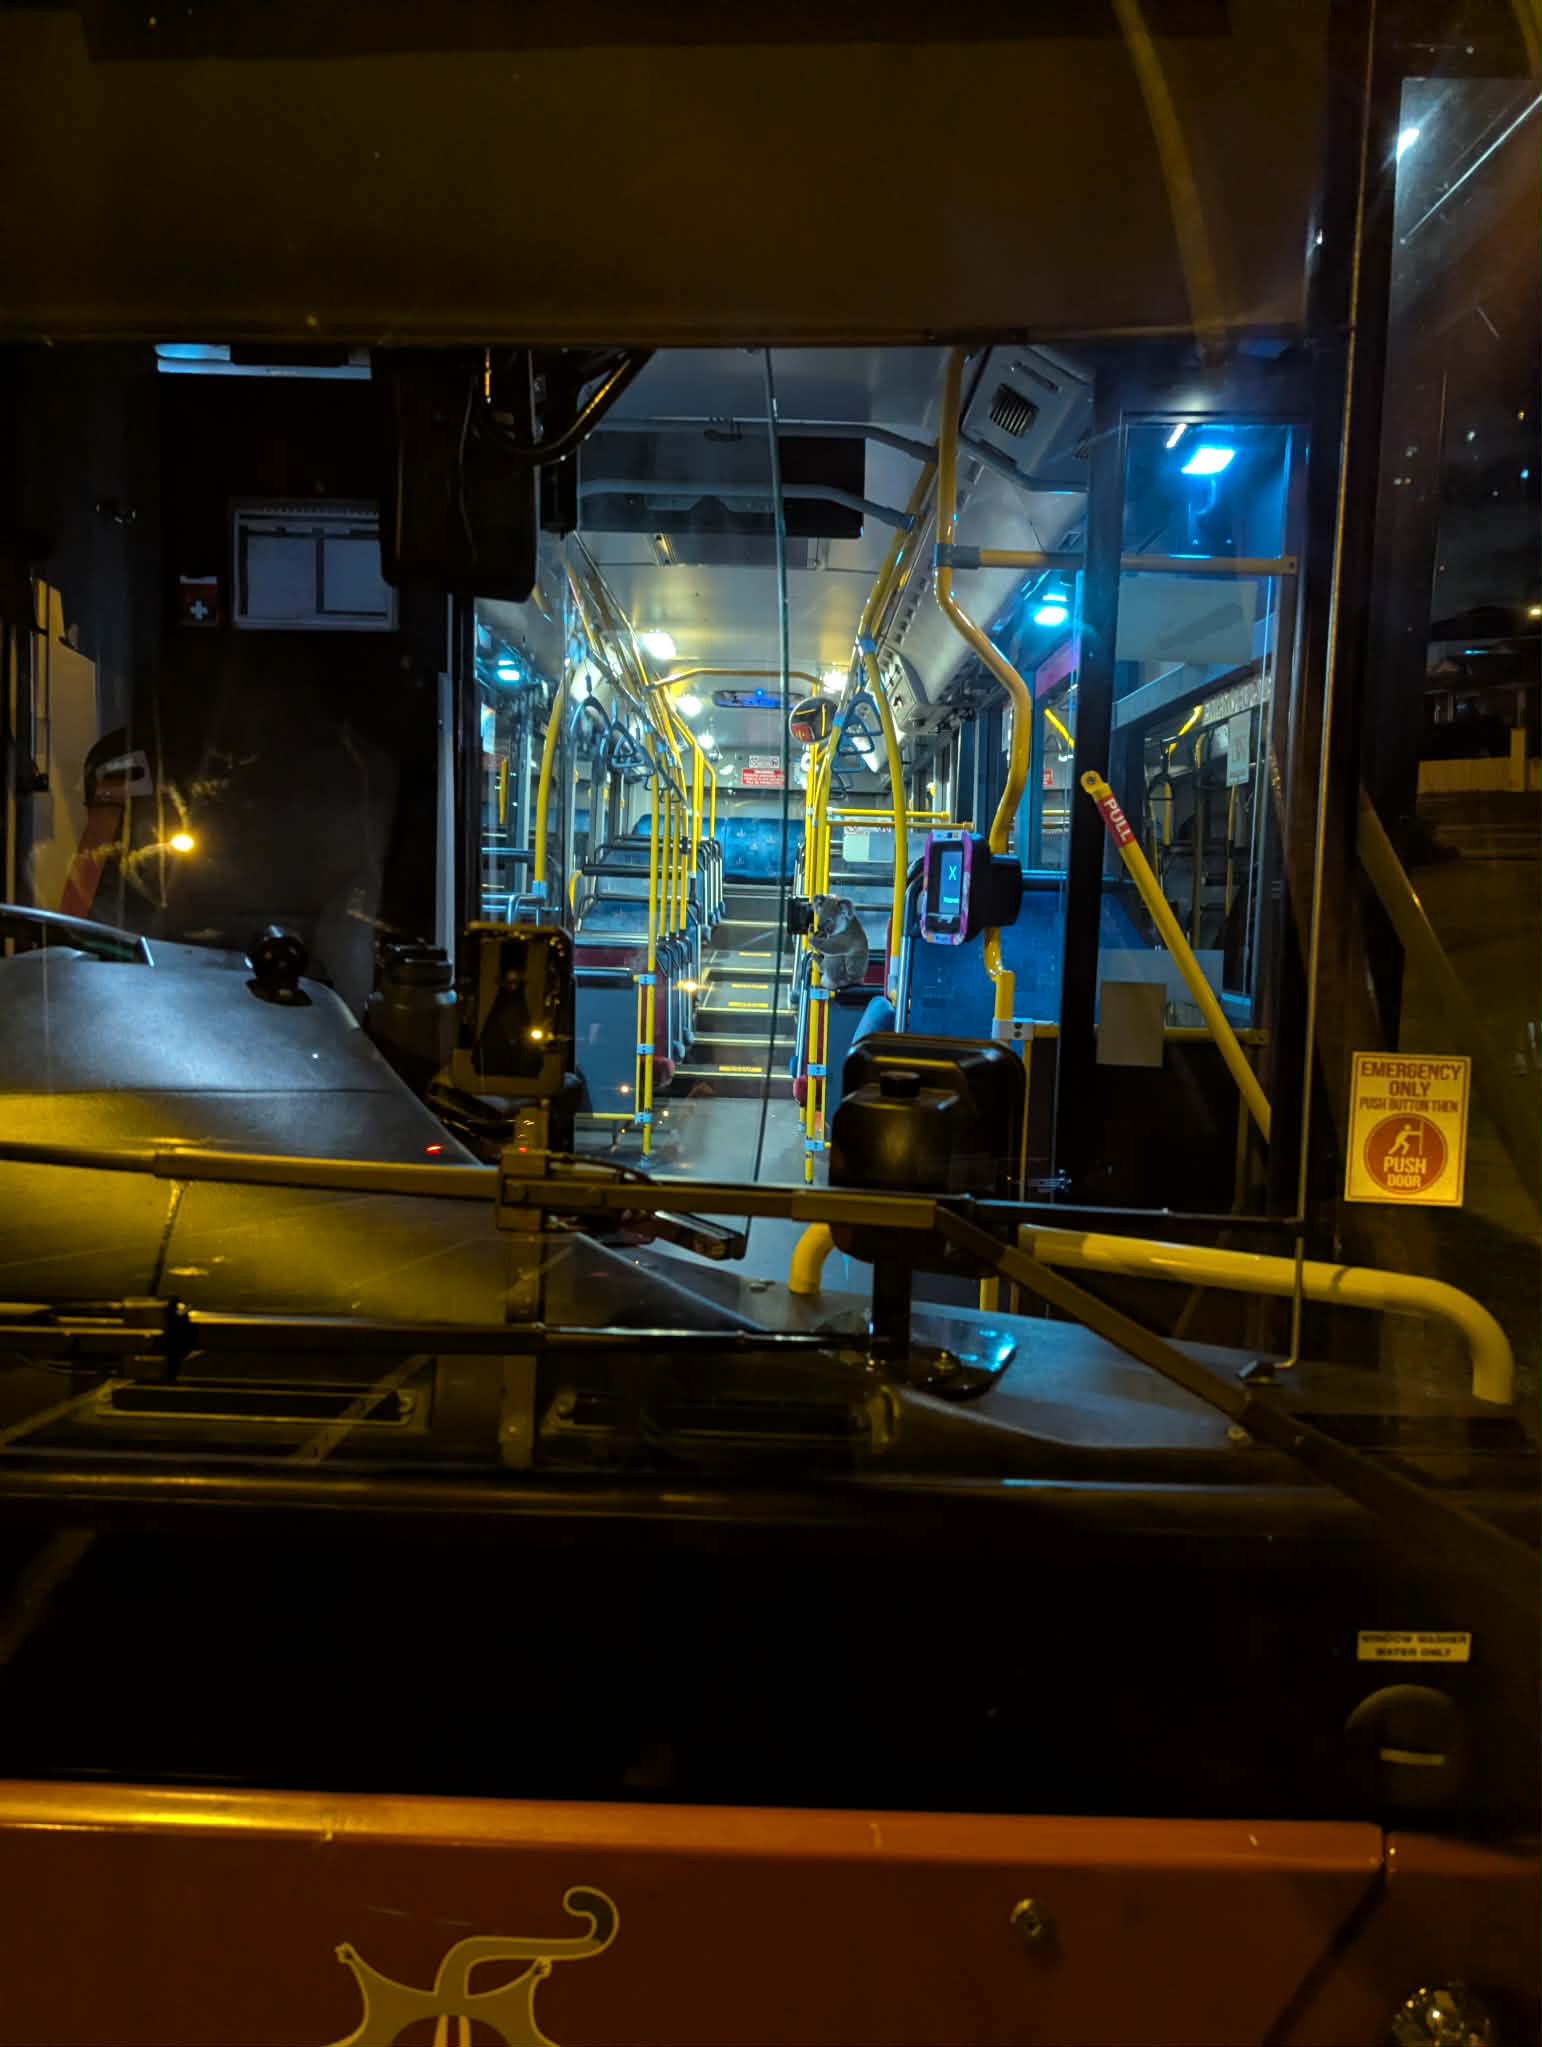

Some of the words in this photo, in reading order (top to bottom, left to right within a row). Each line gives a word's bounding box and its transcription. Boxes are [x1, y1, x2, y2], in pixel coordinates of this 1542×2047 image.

[1104, 797, 1131, 842] PULL
[1360, 1061, 1462, 1081] EMERGENCY
[1389, 1081, 1431, 1097] ONLY
[1360, 1096, 1386, 1111] PUSH
[1389, 1098, 1429, 1112] BUTTON
[1431, 1099, 1459, 1113] THEN
[1384, 1156, 1427, 1174] PUSH
[1387, 1173, 1421, 1187] DOOR
